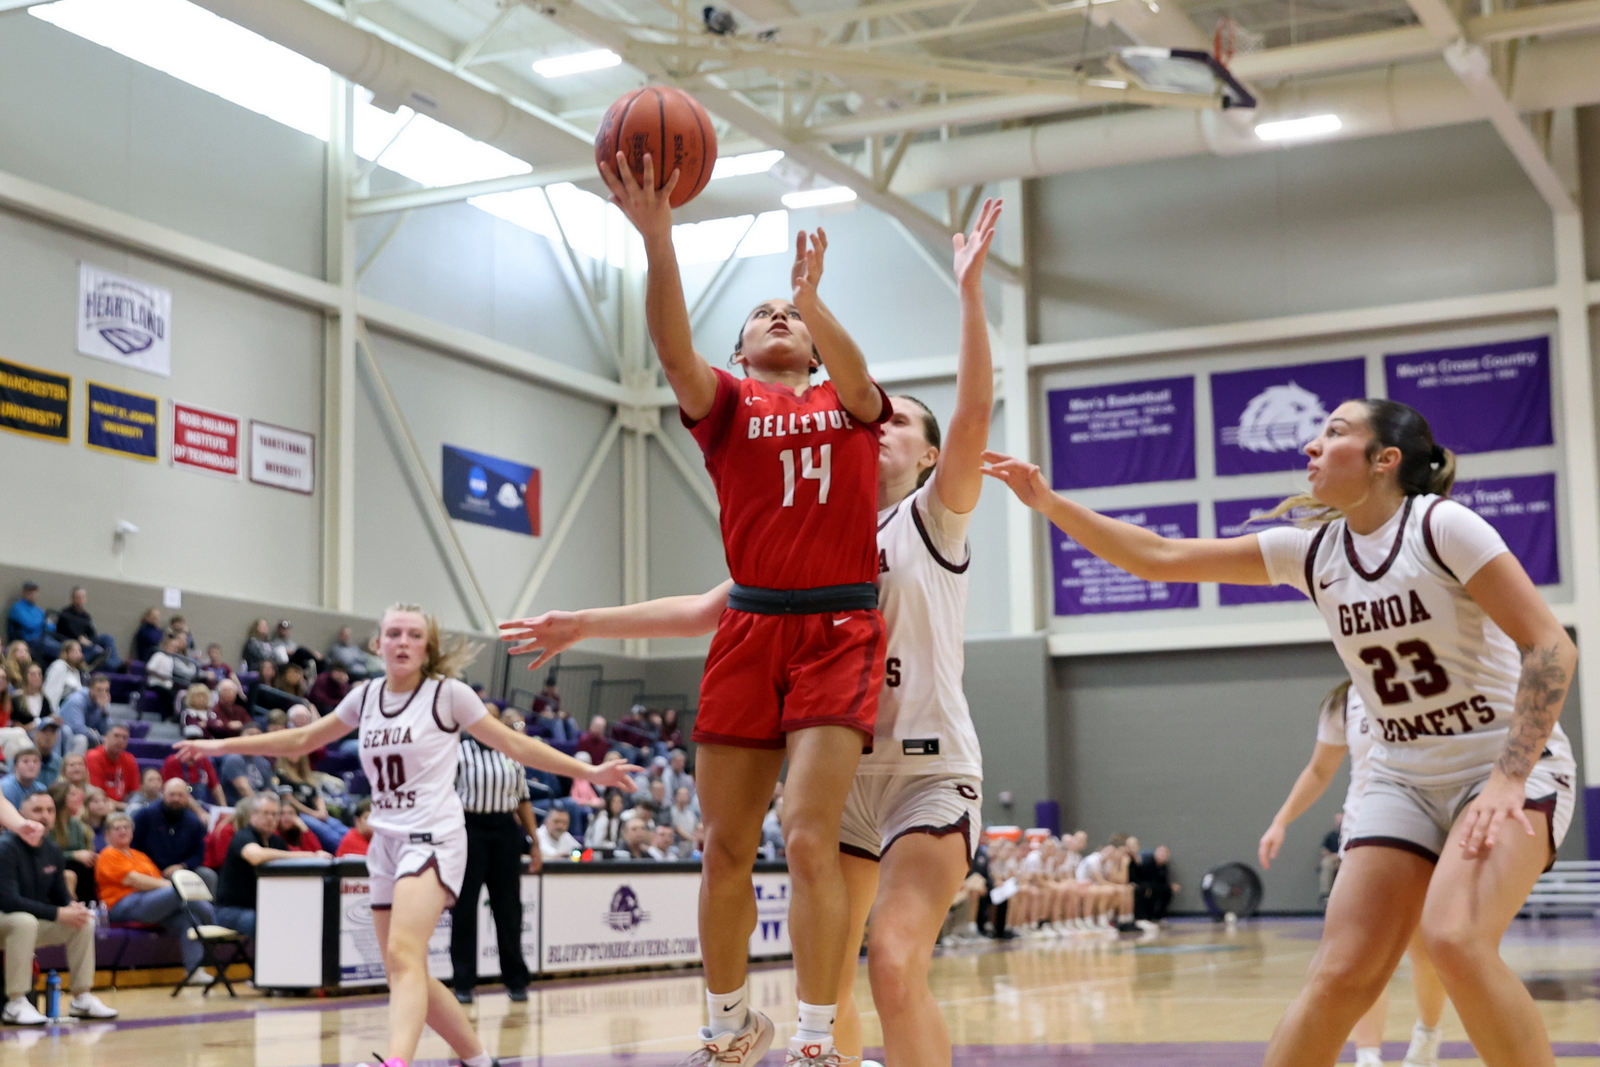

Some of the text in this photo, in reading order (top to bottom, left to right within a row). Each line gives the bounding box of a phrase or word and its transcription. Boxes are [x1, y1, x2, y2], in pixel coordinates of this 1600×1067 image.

[85, 291, 164, 340] HEARTLAND
[1481, 350, 1538, 369] Country
[0, 371, 67, 400] MANCHESTER
[1106, 389, 1173, 409] Basketball
[1, 401, 63, 428] UNIVERSITY
[748, 409, 853, 440] BELLEVUE
[185, 430, 228, 451] INSTITUTE
[779, 443, 832, 507] 14
[1338, 589, 1432, 636] GENOA
[1358, 637, 1452, 706] 23
[363, 726, 413, 748] GENOA
[372, 753, 406, 792] 10
